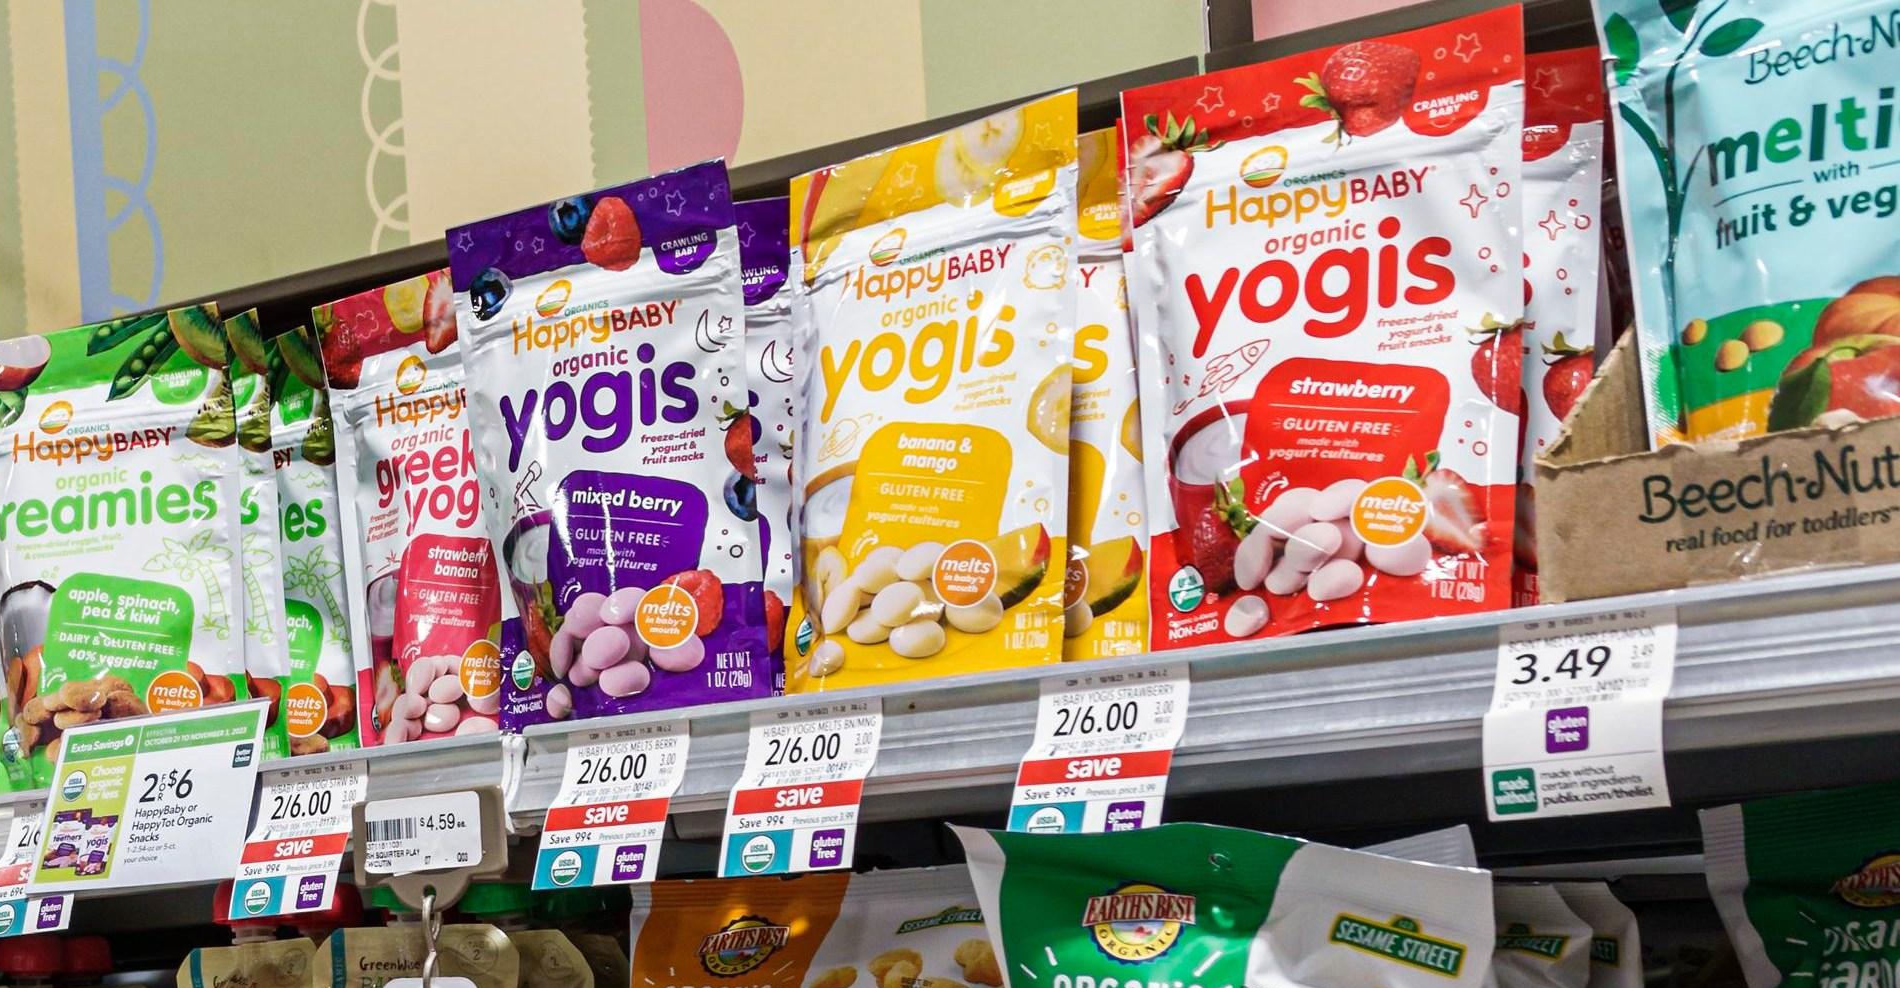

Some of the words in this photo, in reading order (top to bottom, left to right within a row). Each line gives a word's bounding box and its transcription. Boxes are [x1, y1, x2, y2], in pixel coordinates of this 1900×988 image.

[1745, 10, 1900, 85] Beech-N
[1413, 91, 1478, 113] CRAWLING
[1709, 87, 1900, 187] melti
[1283, 169, 1347, 187] ORGANICS
[1813, 160, 1860, 183] with
[1264, 221, 1366, 255] organic
[1716, 203, 1777, 250] fruit
[1184, 216, 1456, 359] yogis
[881, 296, 956, 328] organic
[553, 348, 628, 377] organic
[821, 290, 1016, 423] yogis
[1290, 378, 1414, 404] strawberry
[500, 343, 699, 473] yogis
[641, 428, 706, 443] freeze-dried
[1283, 417, 1345, 435] GLUTEN
[1351, 421, 1391, 437] FREE
[898, 434, 956, 453] banana
[902, 453, 958, 473] mango
[56, 468, 128, 491] organic
[1639, 444, 1900, 524] Beech-Nut
[572, 490, 624, 507] mixed
[629, 491, 682, 517] berry
[880, 484, 929, 498] GLUTEN
[933, 488, 965, 502] FREE
[1359, 495, 1424, 514] melts
[1666, 525, 1705, 554] real
[1712, 522, 1759, 548] food
[1765, 518, 1795, 540] for
[1801, 508, 1890, 535] toddlers
[428, 546, 488, 567] strawberry
[434, 563, 479, 578] banana
[69, 588, 114, 607] apple,
[117, 592, 180, 614] spinach,
[642, 601, 691, 617] melts
[82, 606, 111, 621] pea
[129, 610, 160, 625] kiwi
[1168, 620, 1219, 641] NON-GMO
[1511, 646, 1611, 685] 3.49
[1053, 701, 1138, 737] 2/6.00
[71, 741, 92, 753] Extra
[93, 740, 125, 750] Savings
[765, 733, 841, 766] 2/6.00
[577, 753, 647, 784] 2/6.00
[1065, 755, 1122, 779] save
[140, 773, 158, 802] 2
[774, 785, 823, 808] save
[135, 806, 184, 820] HappyBaby
[271, 790, 332, 821] 2/6.00
[584, 802, 629, 825] save
[132, 818, 175, 832] HappyTot
[420, 813, 455, 830] $4.59
[129, 831, 159, 844] Snacks
[813, 835, 843, 849] gluten
[816, 847, 836, 859] free
[1155, 897, 1195, 922] BEST
[1335, 919, 1397, 958] SESAME
[1399, 937, 1461, 971] STREET
